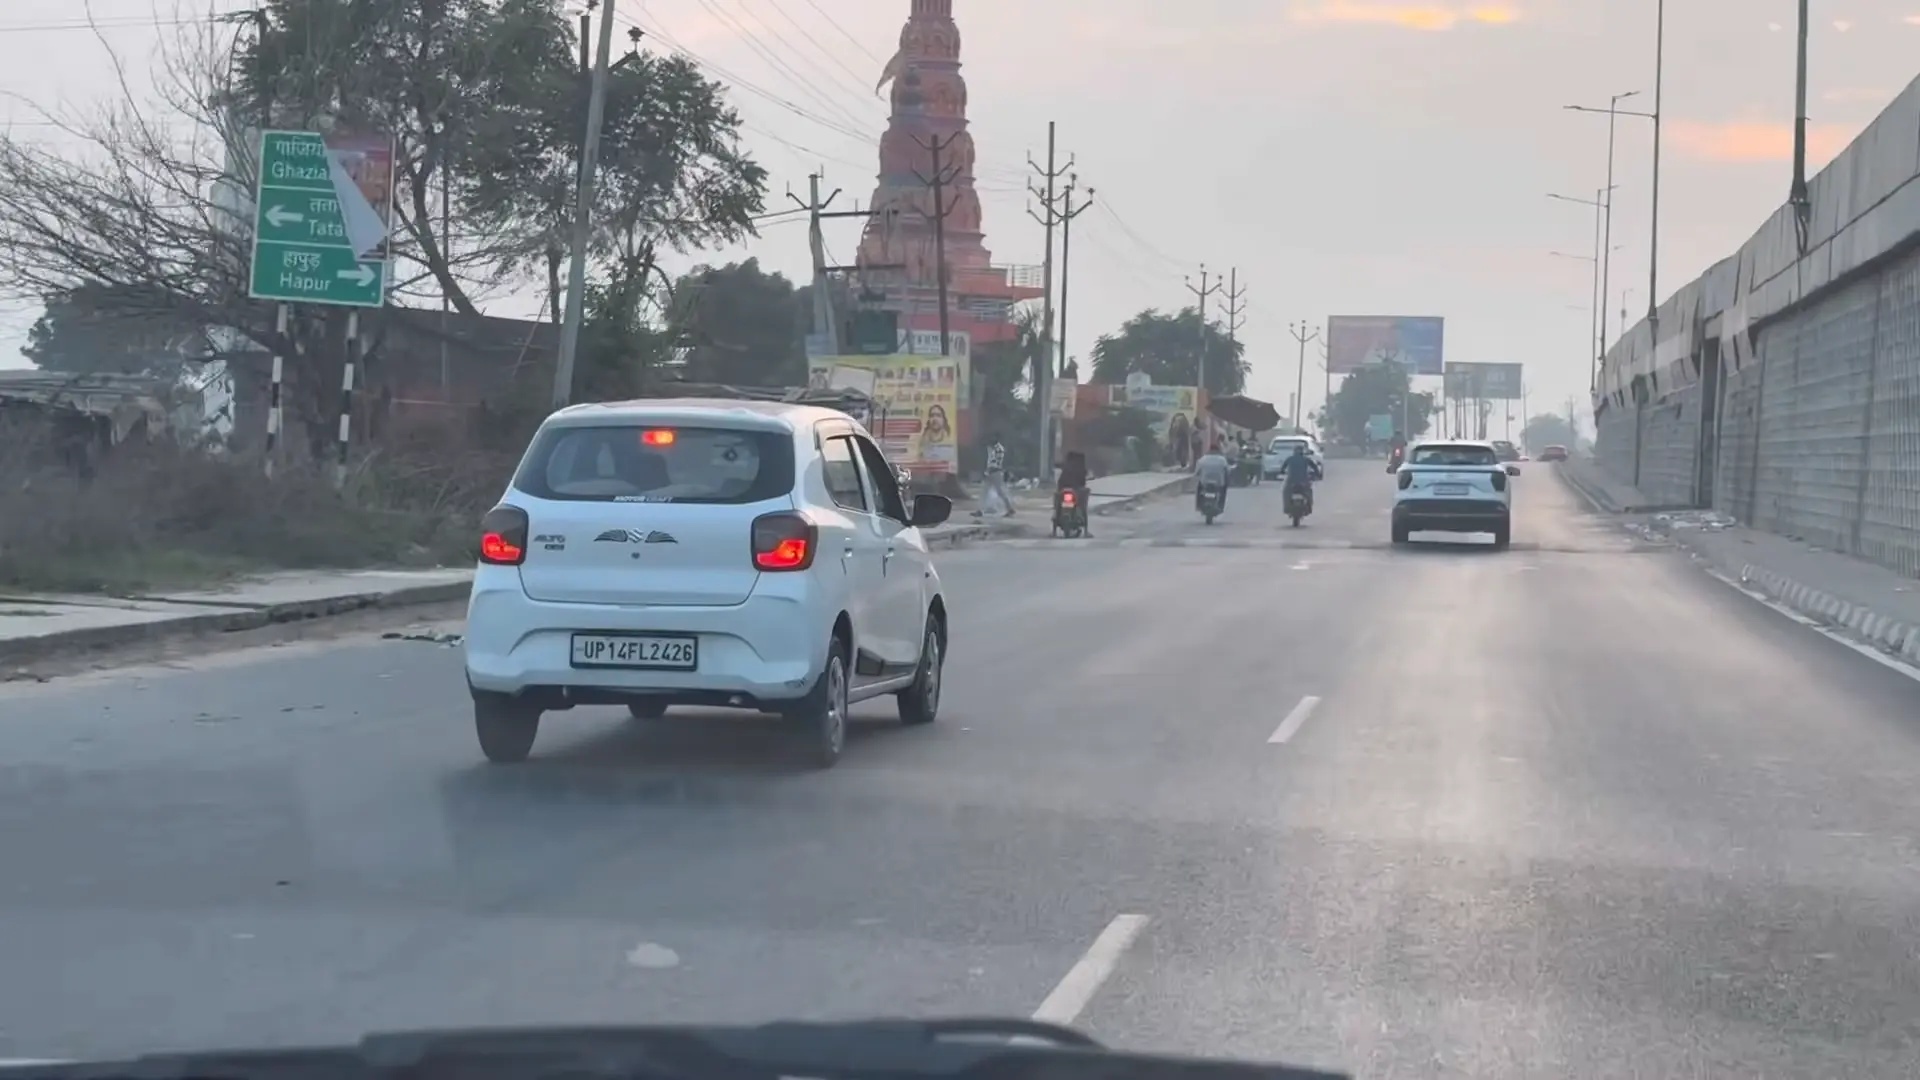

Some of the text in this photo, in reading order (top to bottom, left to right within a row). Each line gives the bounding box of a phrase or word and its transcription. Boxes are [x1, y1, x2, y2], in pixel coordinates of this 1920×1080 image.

[272, 161, 327, 180] Ghazia
[309, 219, 343, 237] Tata
[283, 251, 322, 272] हापुड़
[280, 272, 332, 292] Hapur
[584, 641, 693, 662] UP14FL2426
